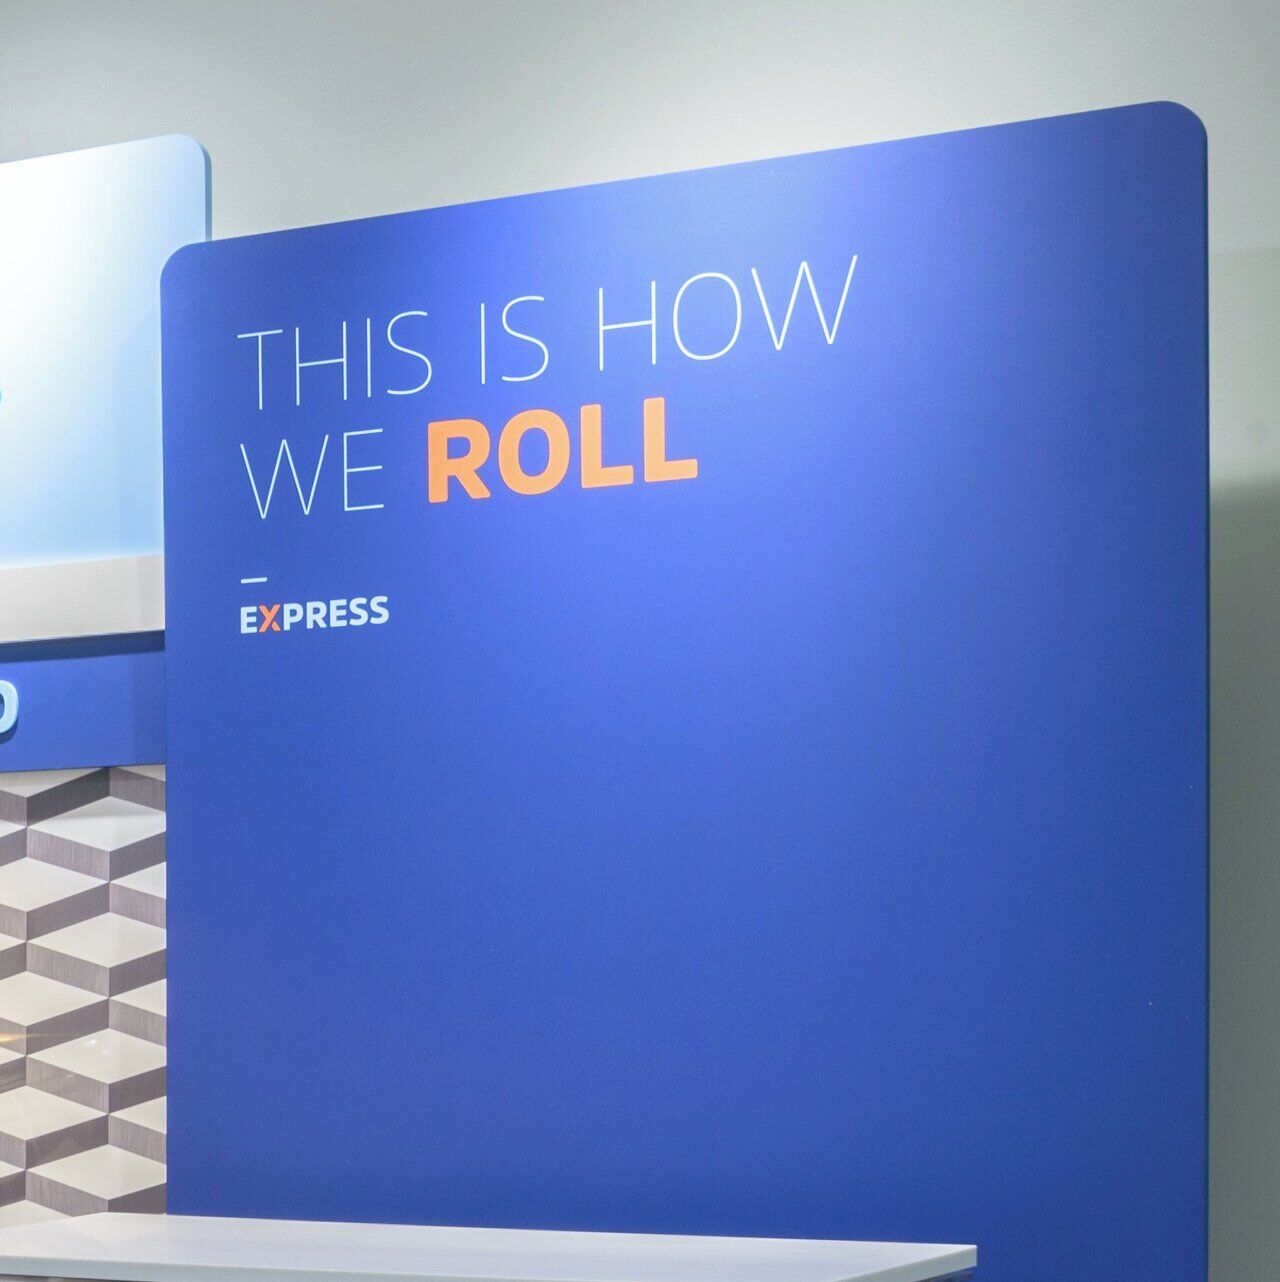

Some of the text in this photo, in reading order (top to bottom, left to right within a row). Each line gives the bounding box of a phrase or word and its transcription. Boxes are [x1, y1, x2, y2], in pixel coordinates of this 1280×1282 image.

[237, 254, 858, 410] THIS IS HOW
[240, 396, 699, 520] WE ROLL
[240, 595, 390, 634] EXPRESS
